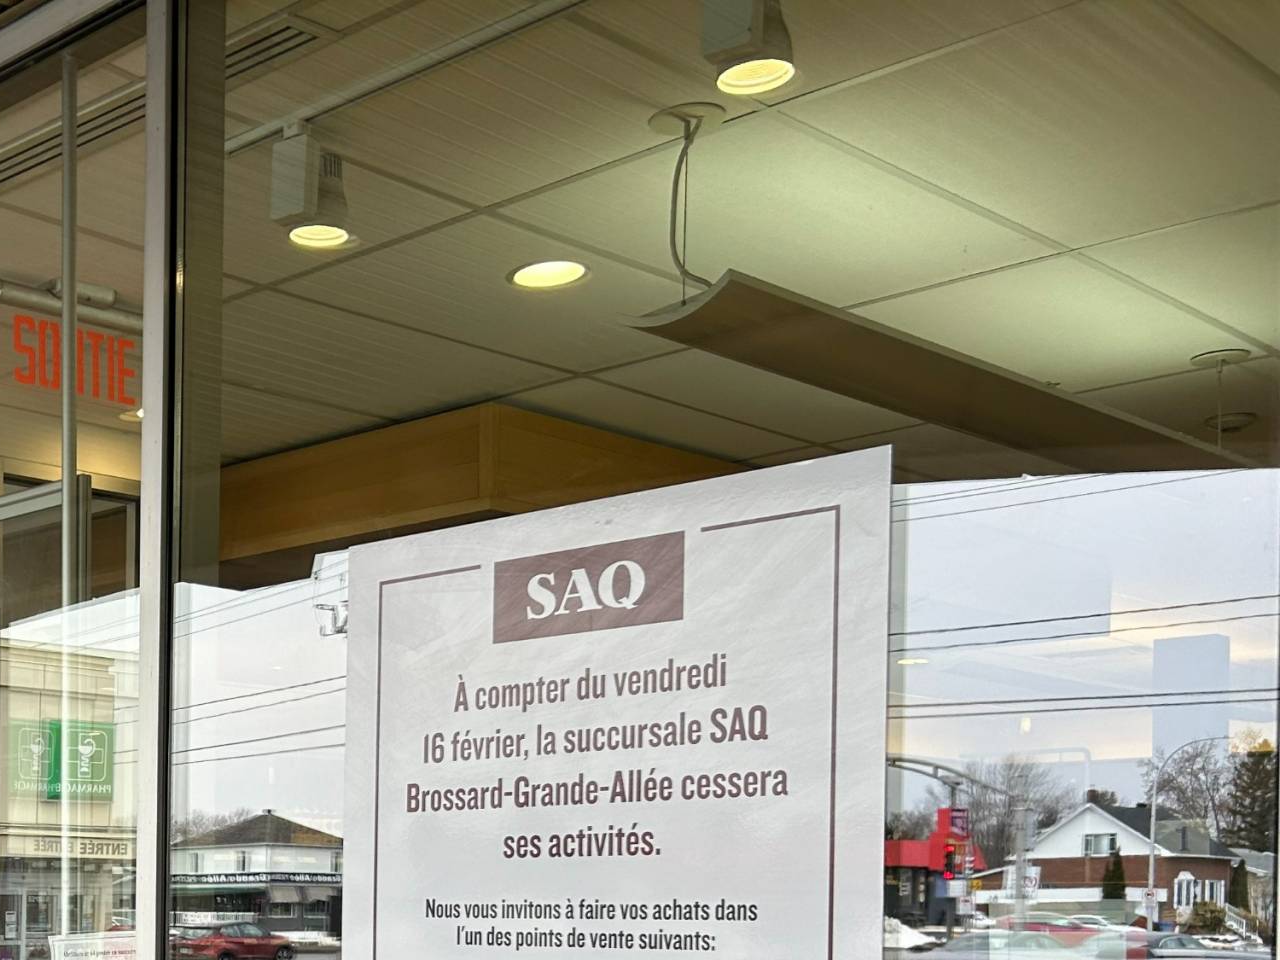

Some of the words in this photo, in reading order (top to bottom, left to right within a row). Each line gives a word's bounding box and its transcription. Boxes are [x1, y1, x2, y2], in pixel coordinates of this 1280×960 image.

[526, 559, 646, 620] SAQ
[453, 673, 469, 713] À
[475, 676, 570, 713] compter
[576, 667, 606, 701] du
[613, 652, 727, 697] vendredi
[423, 732, 445, 764] 16
[450, 728, 529, 761] février,
[536, 723, 557, 756] la
[563, 711, 702, 754] succursale
[709, 704, 768, 744] SAQ
[406, 767, 673, 813] Brossard-Grande-Allée
[681, 769, 788, 800] cessera
[502, 834, 541, 859] ses
[548, 822, 661, 858] activités.
[425, 898, 461, 919] Nous
[464, 903, 498, 919] vous
[501, 898, 561, 919] invitons
[564, 898, 575, 919] à
[578, 898, 616, 920] faire
[619, 903, 648, 920] vos
[652, 898, 710, 920] achats
[714, 898, 758, 921] dans
[486, 925, 512, 947] des
[515, 927, 563, 951] points
[566, 926, 586, 948] de
[589, 930, 634, 949] vente
[638, 928, 715, 951] suivants:
